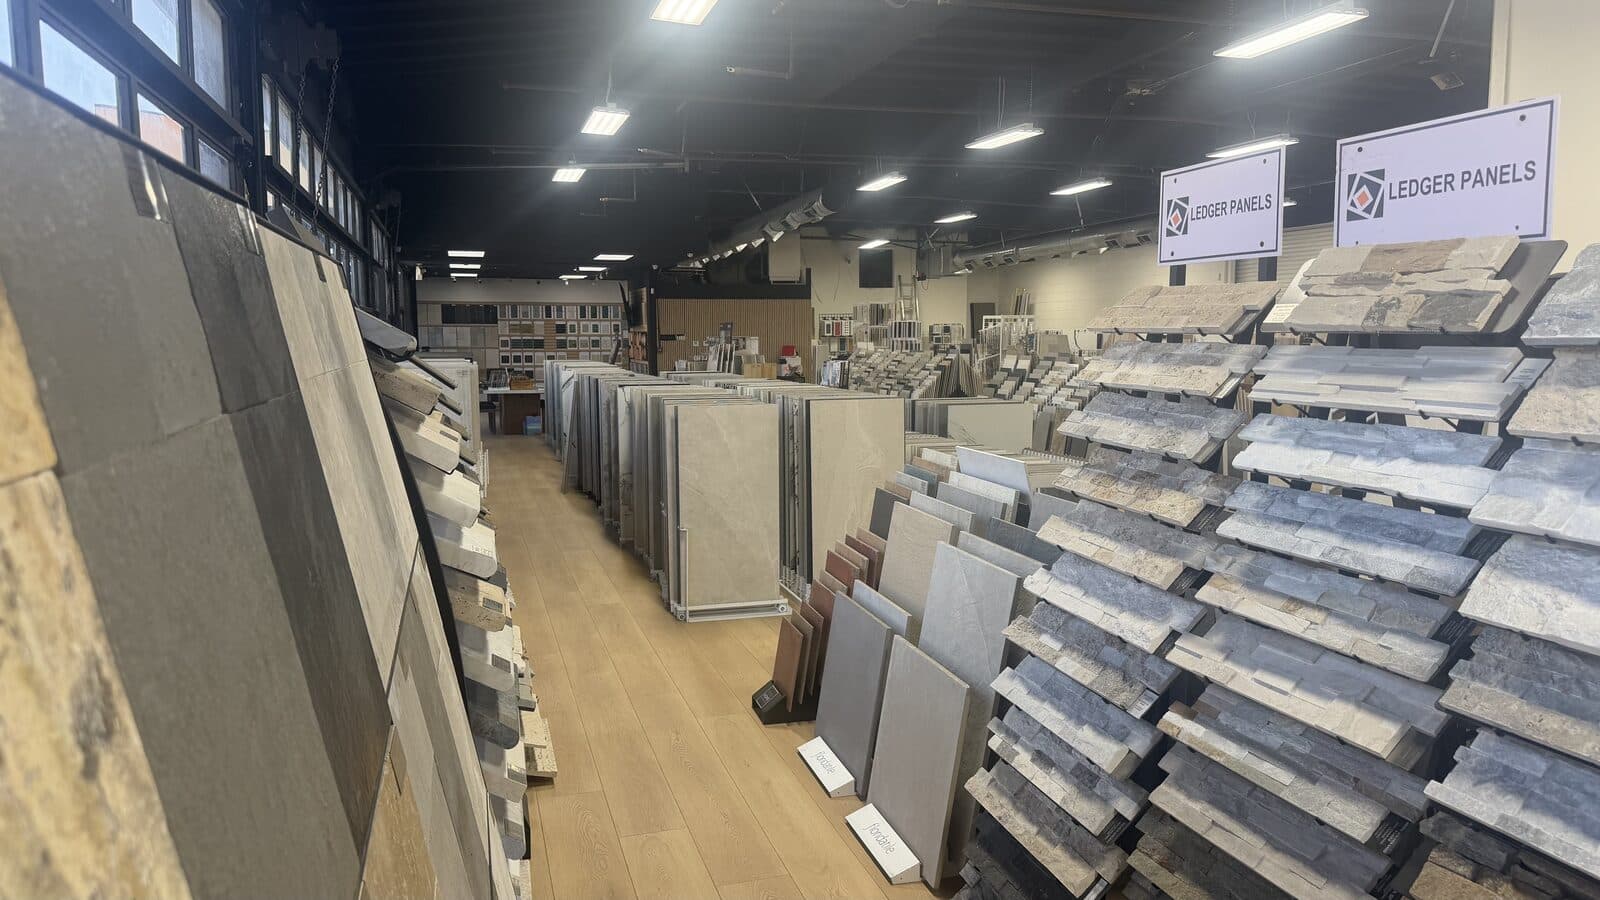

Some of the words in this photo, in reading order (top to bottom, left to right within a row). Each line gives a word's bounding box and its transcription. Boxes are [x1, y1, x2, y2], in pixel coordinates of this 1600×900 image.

[1389, 173, 1456, 201] LEDGER
[1460, 160, 1537, 191] PANELS
[1190, 201, 1228, 222] LEDGER
[1230, 193, 1272, 215] PANELS
